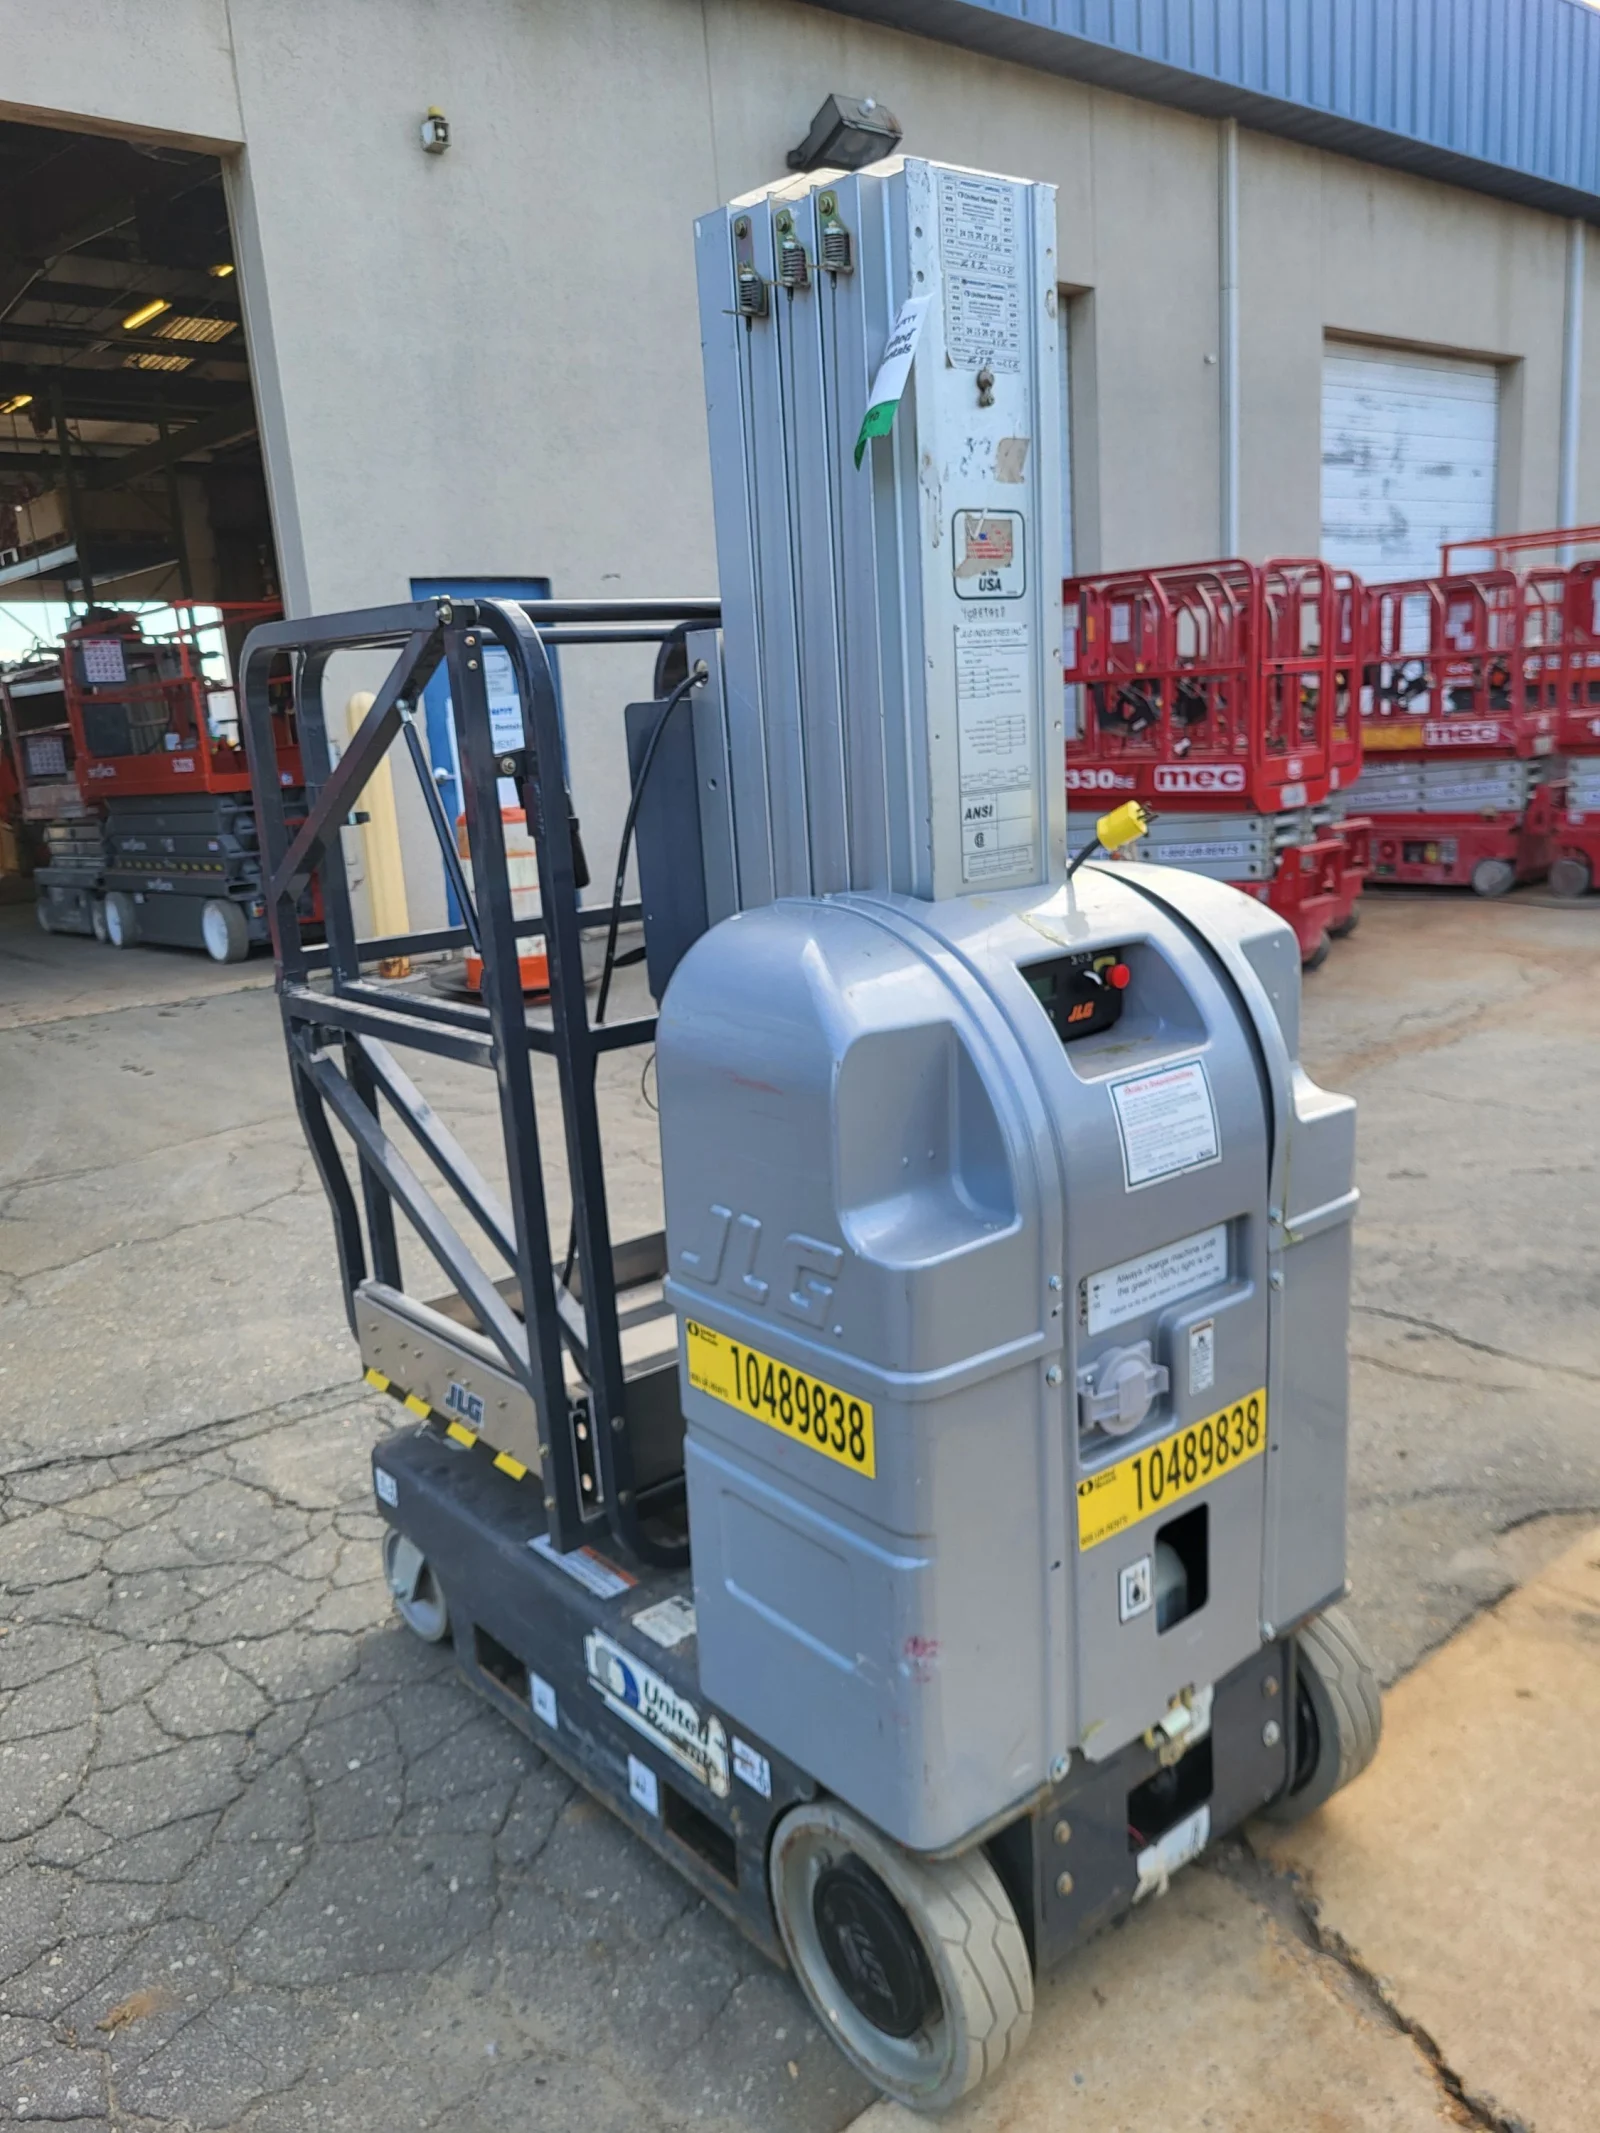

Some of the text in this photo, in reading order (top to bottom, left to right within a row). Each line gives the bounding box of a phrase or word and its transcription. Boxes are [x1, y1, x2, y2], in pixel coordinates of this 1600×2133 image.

[979, 577, 1002, 592] USA
[1426, 726, 1497, 742] mec
[1157, 768, 1242, 788] mec
[964, 804, 994, 821] ANSI
[1068, 1001, 1095, 1022] JLG
[680, 1203, 844, 1332] JLG
[1116, 1268, 1144, 1284] Always
[1144, 1257, 1170, 1275] charge
[1171, 1244, 1200, 1262] machine
[1117, 1285, 1130, 1297] the
[1131, 1278, 1153, 1294] green
[445, 1384, 484, 1424] JLG
[731, 1345, 865, 1463] 10489838
[1132, 1397, 1259, 1511] 10489838
